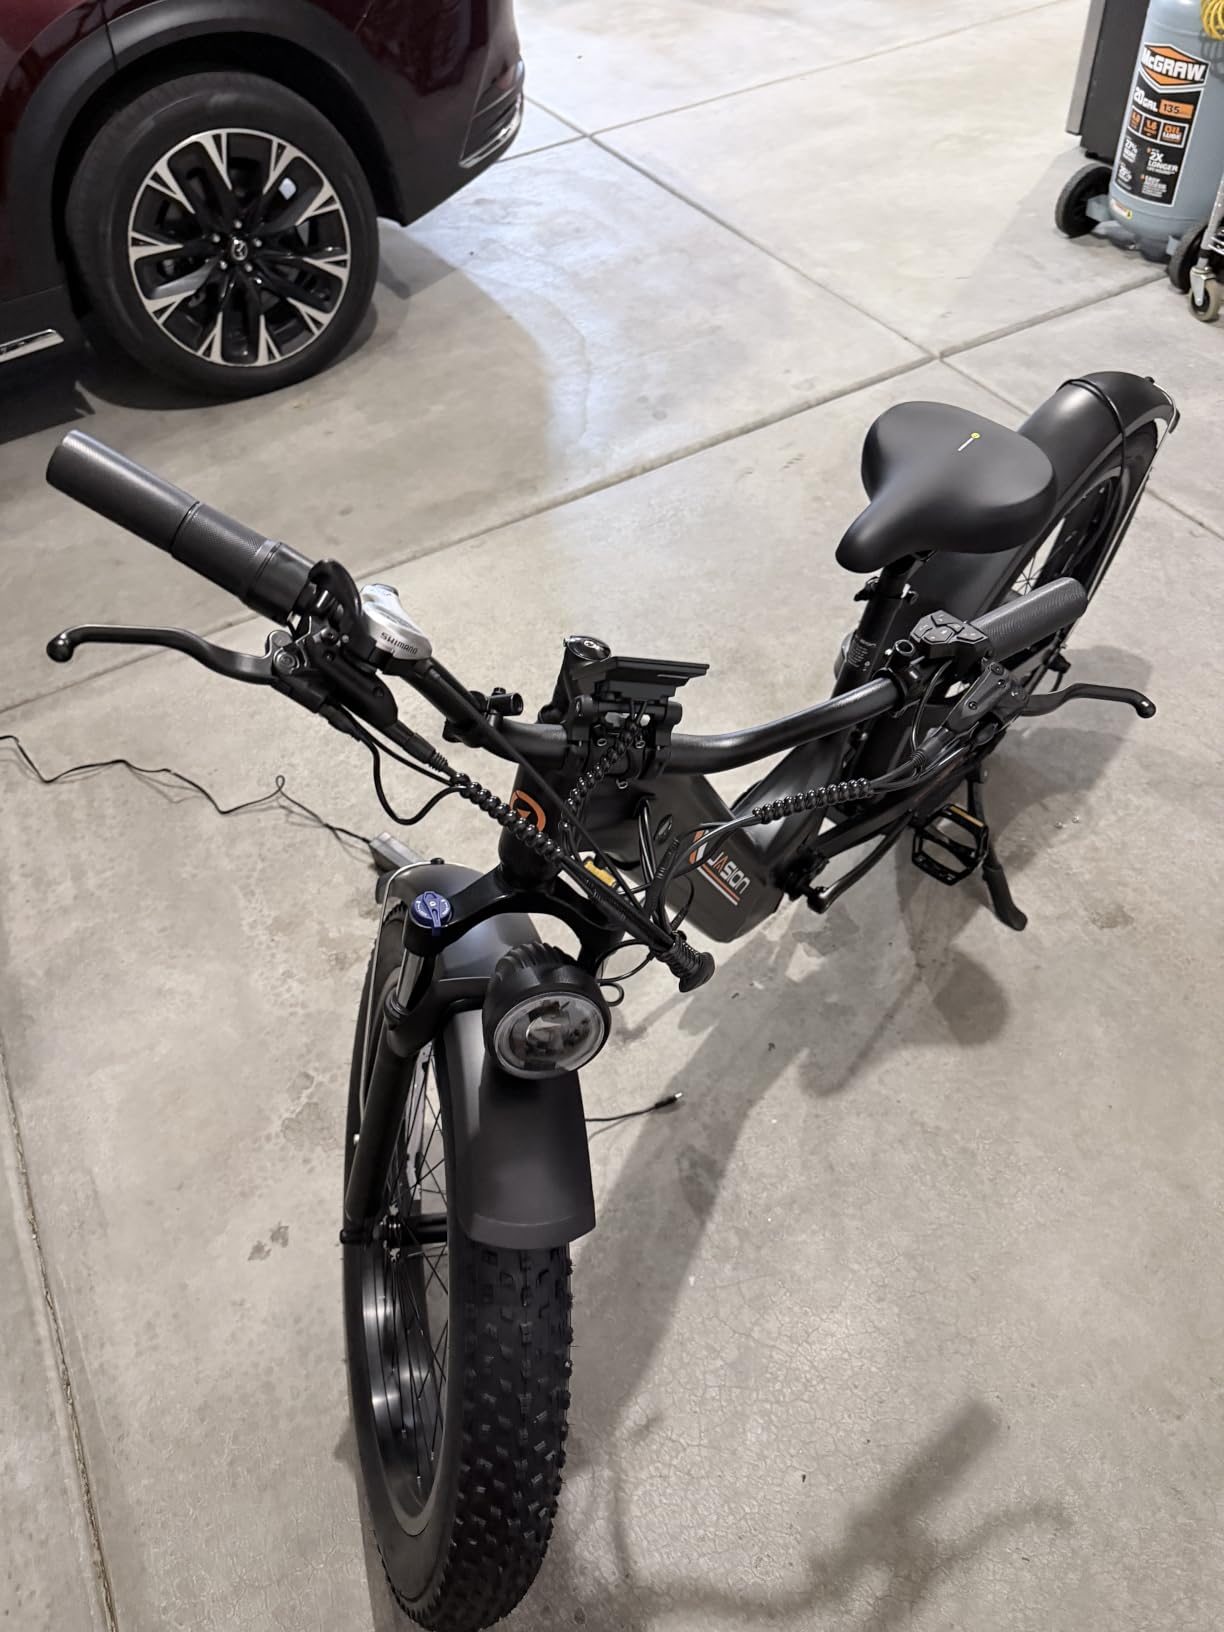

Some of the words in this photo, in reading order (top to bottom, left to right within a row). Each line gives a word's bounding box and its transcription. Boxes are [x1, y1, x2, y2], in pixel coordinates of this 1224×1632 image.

[1163, 103, 1180, 114] 135
[1149, 151, 1164, 163] 2X
[1147, 160, 1179, 172] LONGER
[380, 631, 418, 655] SHIMANO
[707, 851, 751, 894] JASION
